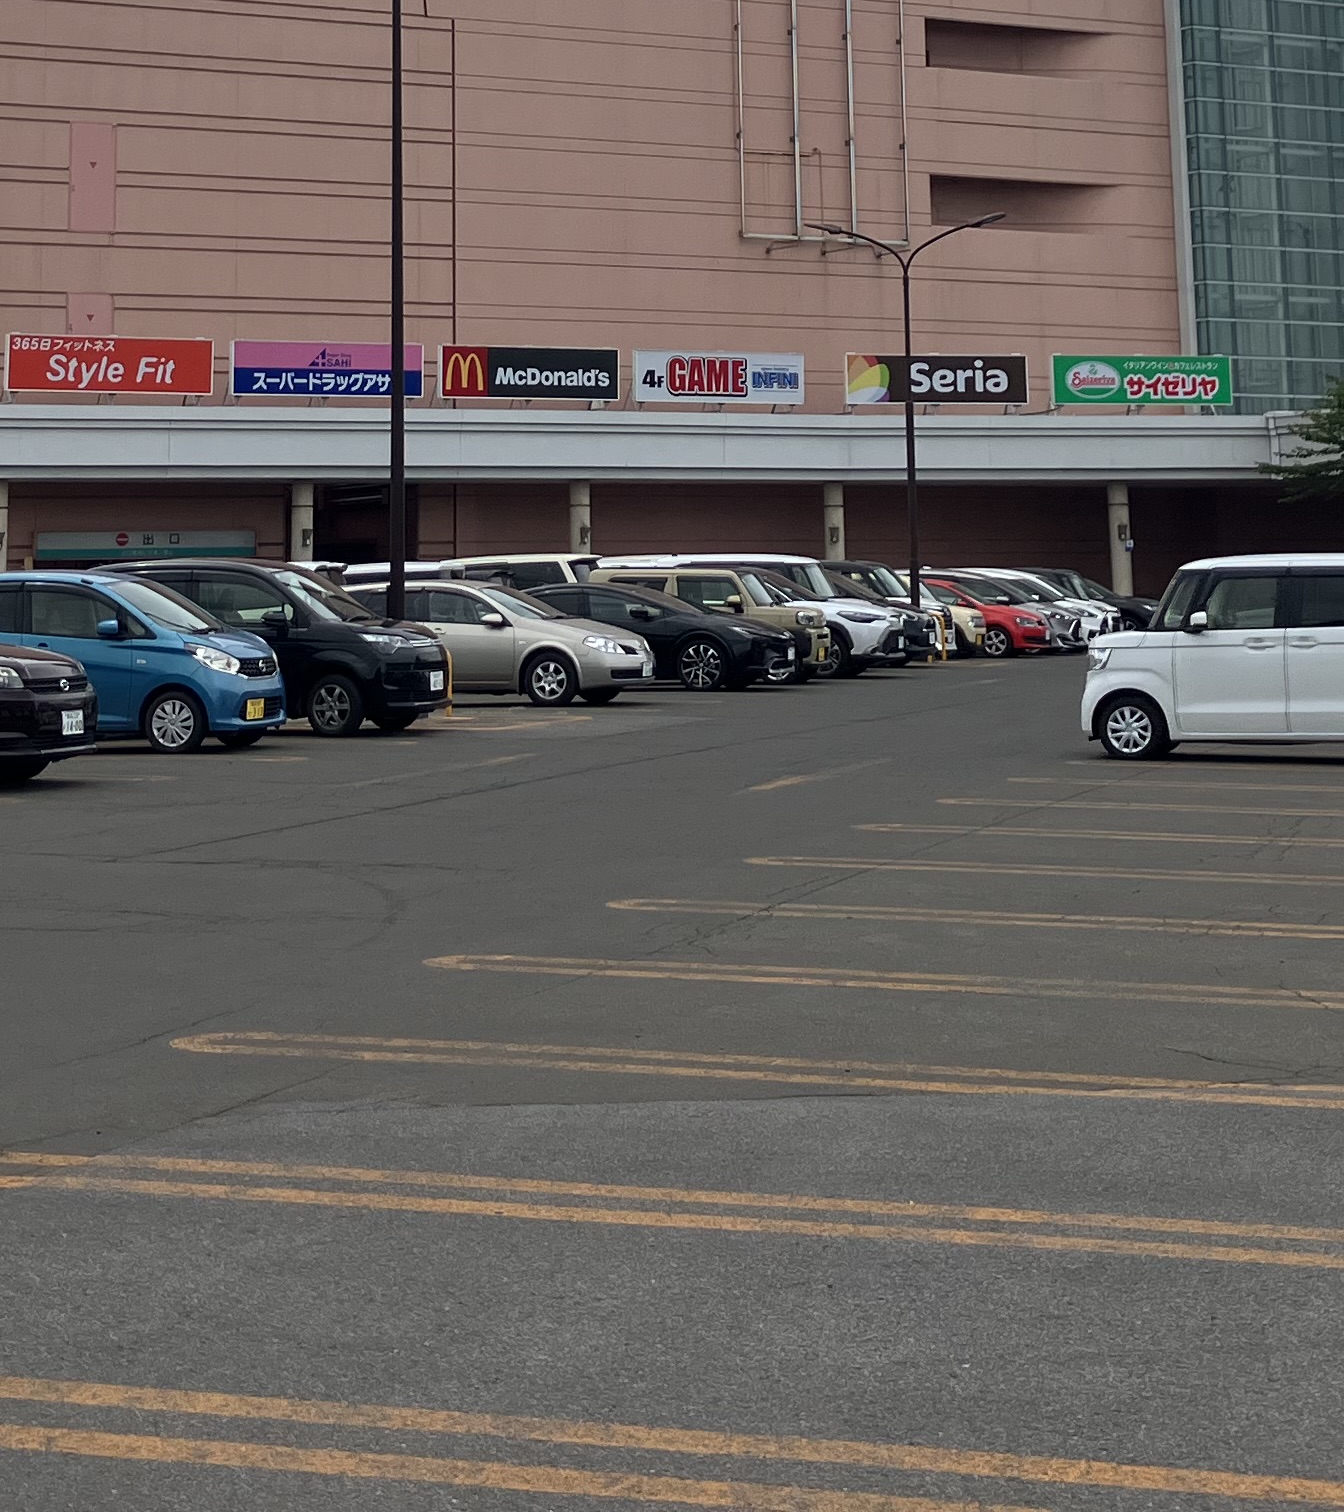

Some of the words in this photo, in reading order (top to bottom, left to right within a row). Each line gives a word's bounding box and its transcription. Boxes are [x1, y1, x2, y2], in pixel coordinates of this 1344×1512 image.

[12, 338, 115, 352] 365日フィットネス
[46, 354, 125, 389] Style
[136, 357, 176, 384] Fit
[252, 372, 391, 393] スーパードラッグアサ
[495, 367, 610, 387] McDonald's
[642, 370, 665, 388] 4F
[667, 355, 748, 397] GAME
[910, 359, 1009, 393] Seria
[1125, 374, 1218, 398] サイゼリヤ
